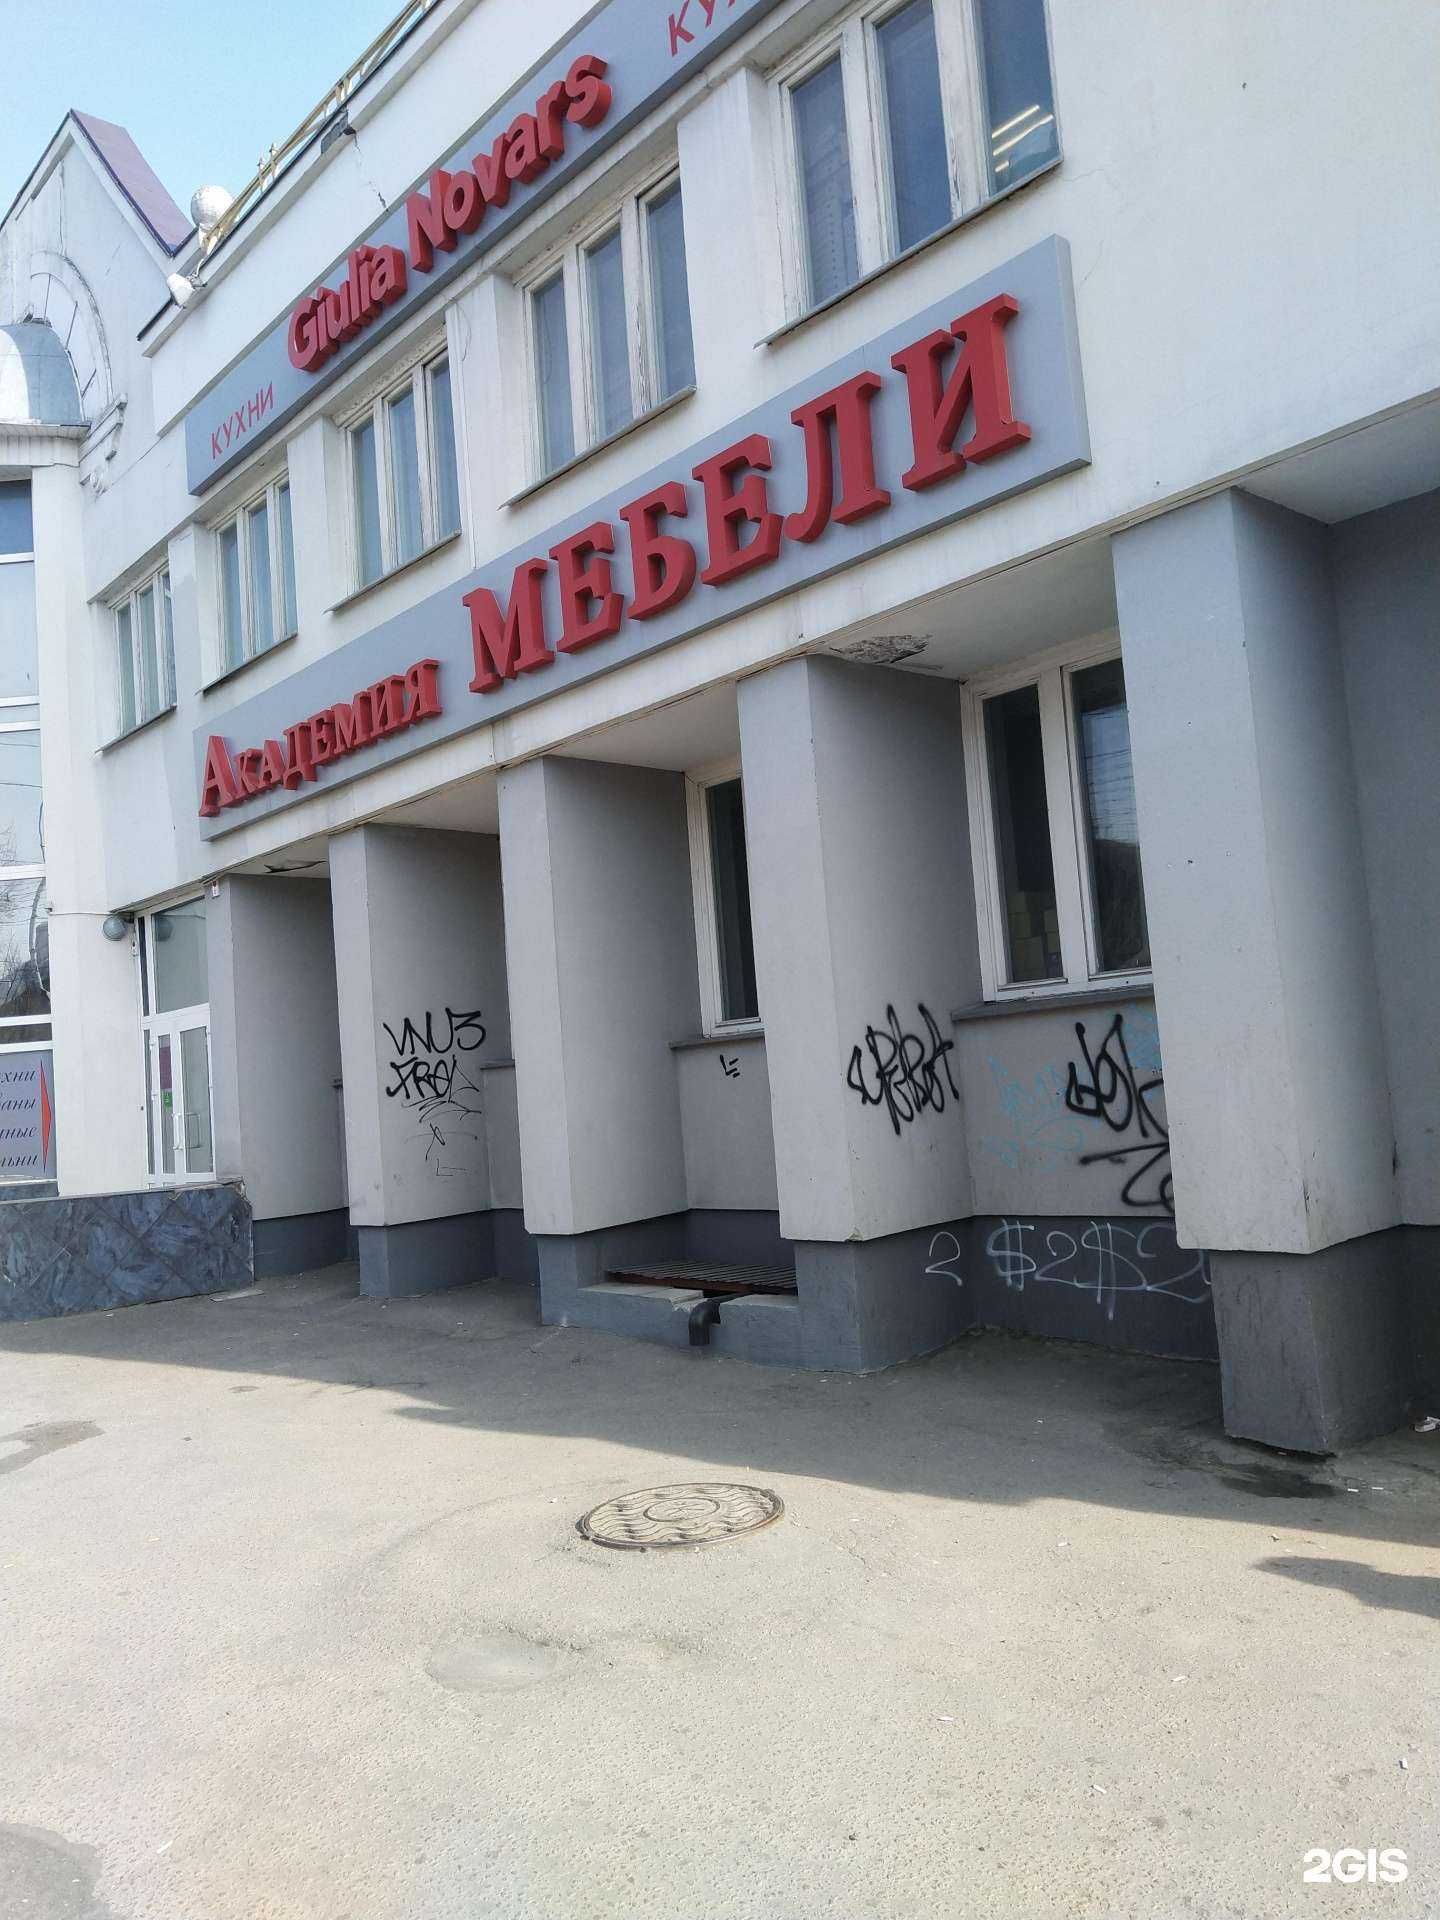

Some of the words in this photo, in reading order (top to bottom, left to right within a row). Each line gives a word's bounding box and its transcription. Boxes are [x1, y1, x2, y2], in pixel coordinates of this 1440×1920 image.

[668, 0, 736, 58] КУ
[288, 245, 407, 372] Giulia
[406, 54, 612, 273] Novars
[210, 380, 275, 460] КУХНИ
[462, 293, 1032, 693] МЕБЕЛИ
[0, 1069, 36, 1084] хни
